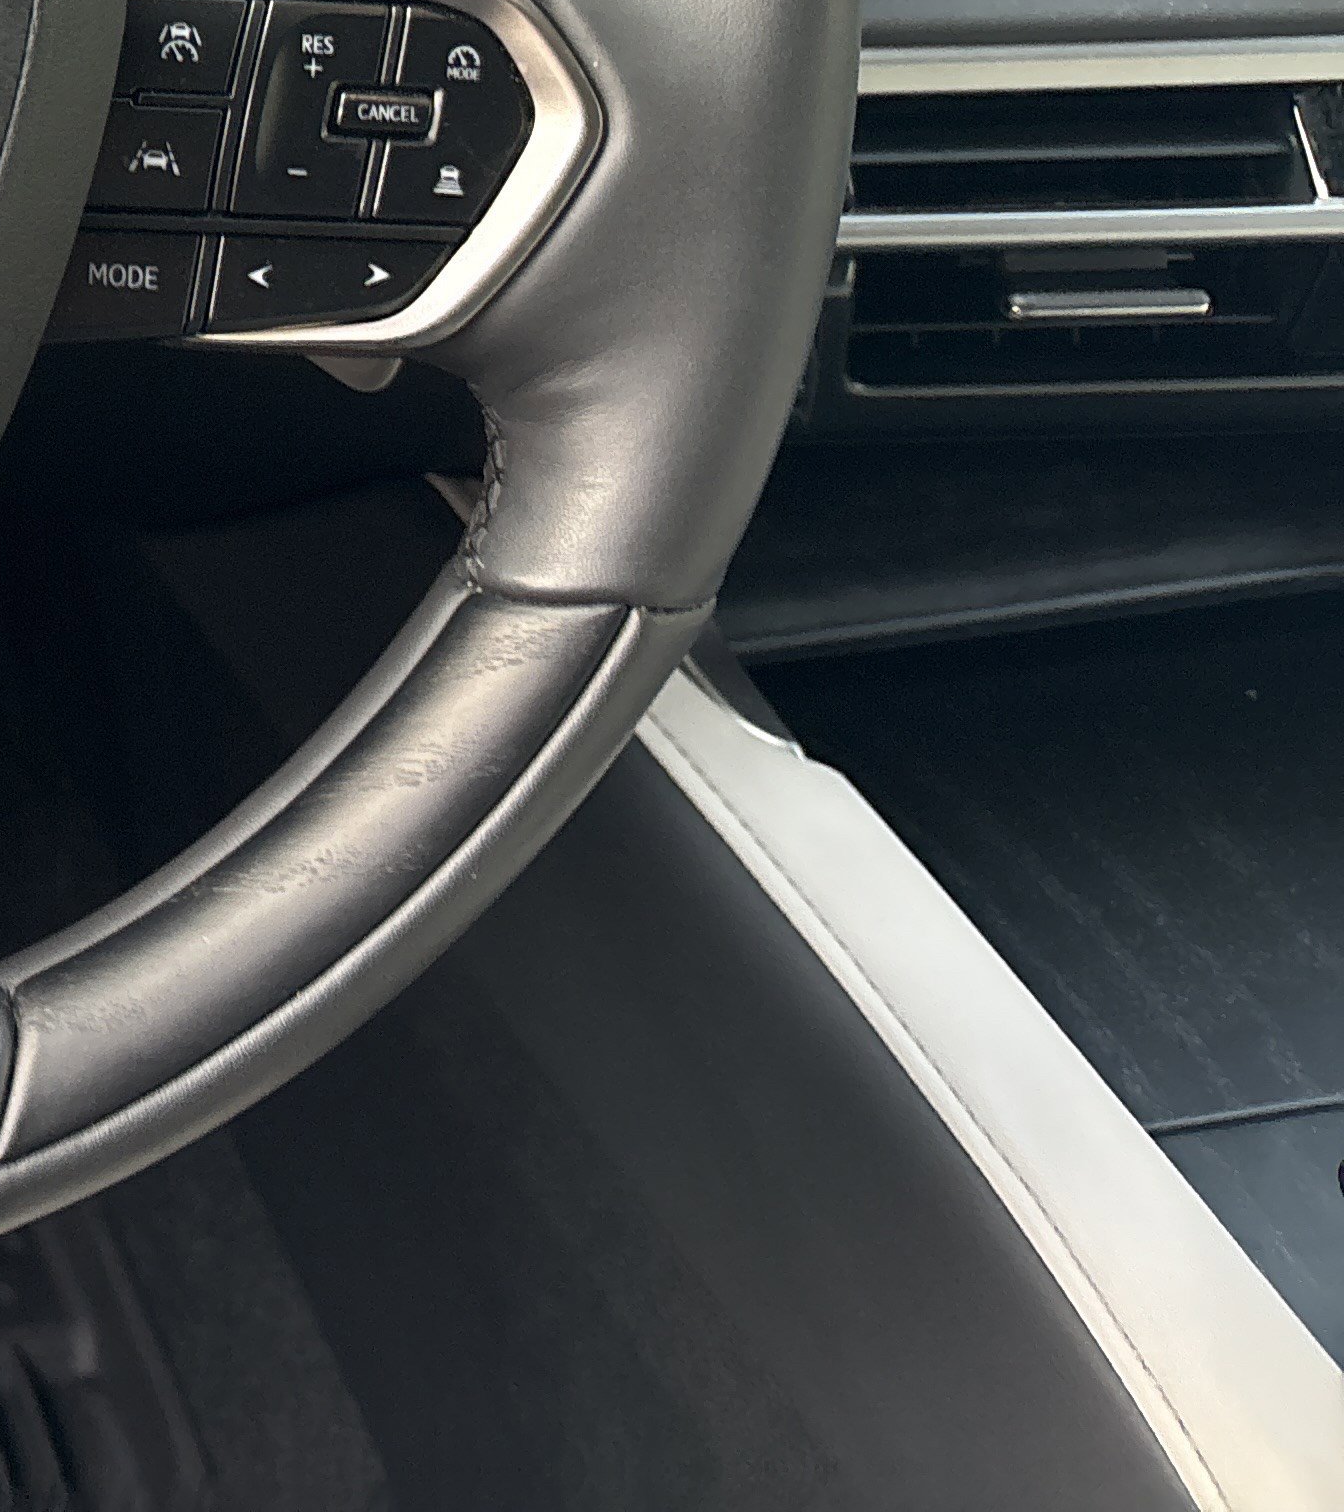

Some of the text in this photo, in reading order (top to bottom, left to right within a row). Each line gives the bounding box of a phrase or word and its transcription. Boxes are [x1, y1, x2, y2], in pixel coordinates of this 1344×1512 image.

[301, 33, 335, 55] RES
[446, 65, 481, 82] MODE
[357, 103, 420, 123] CANCEL
[87, 263, 160, 292] MODE
